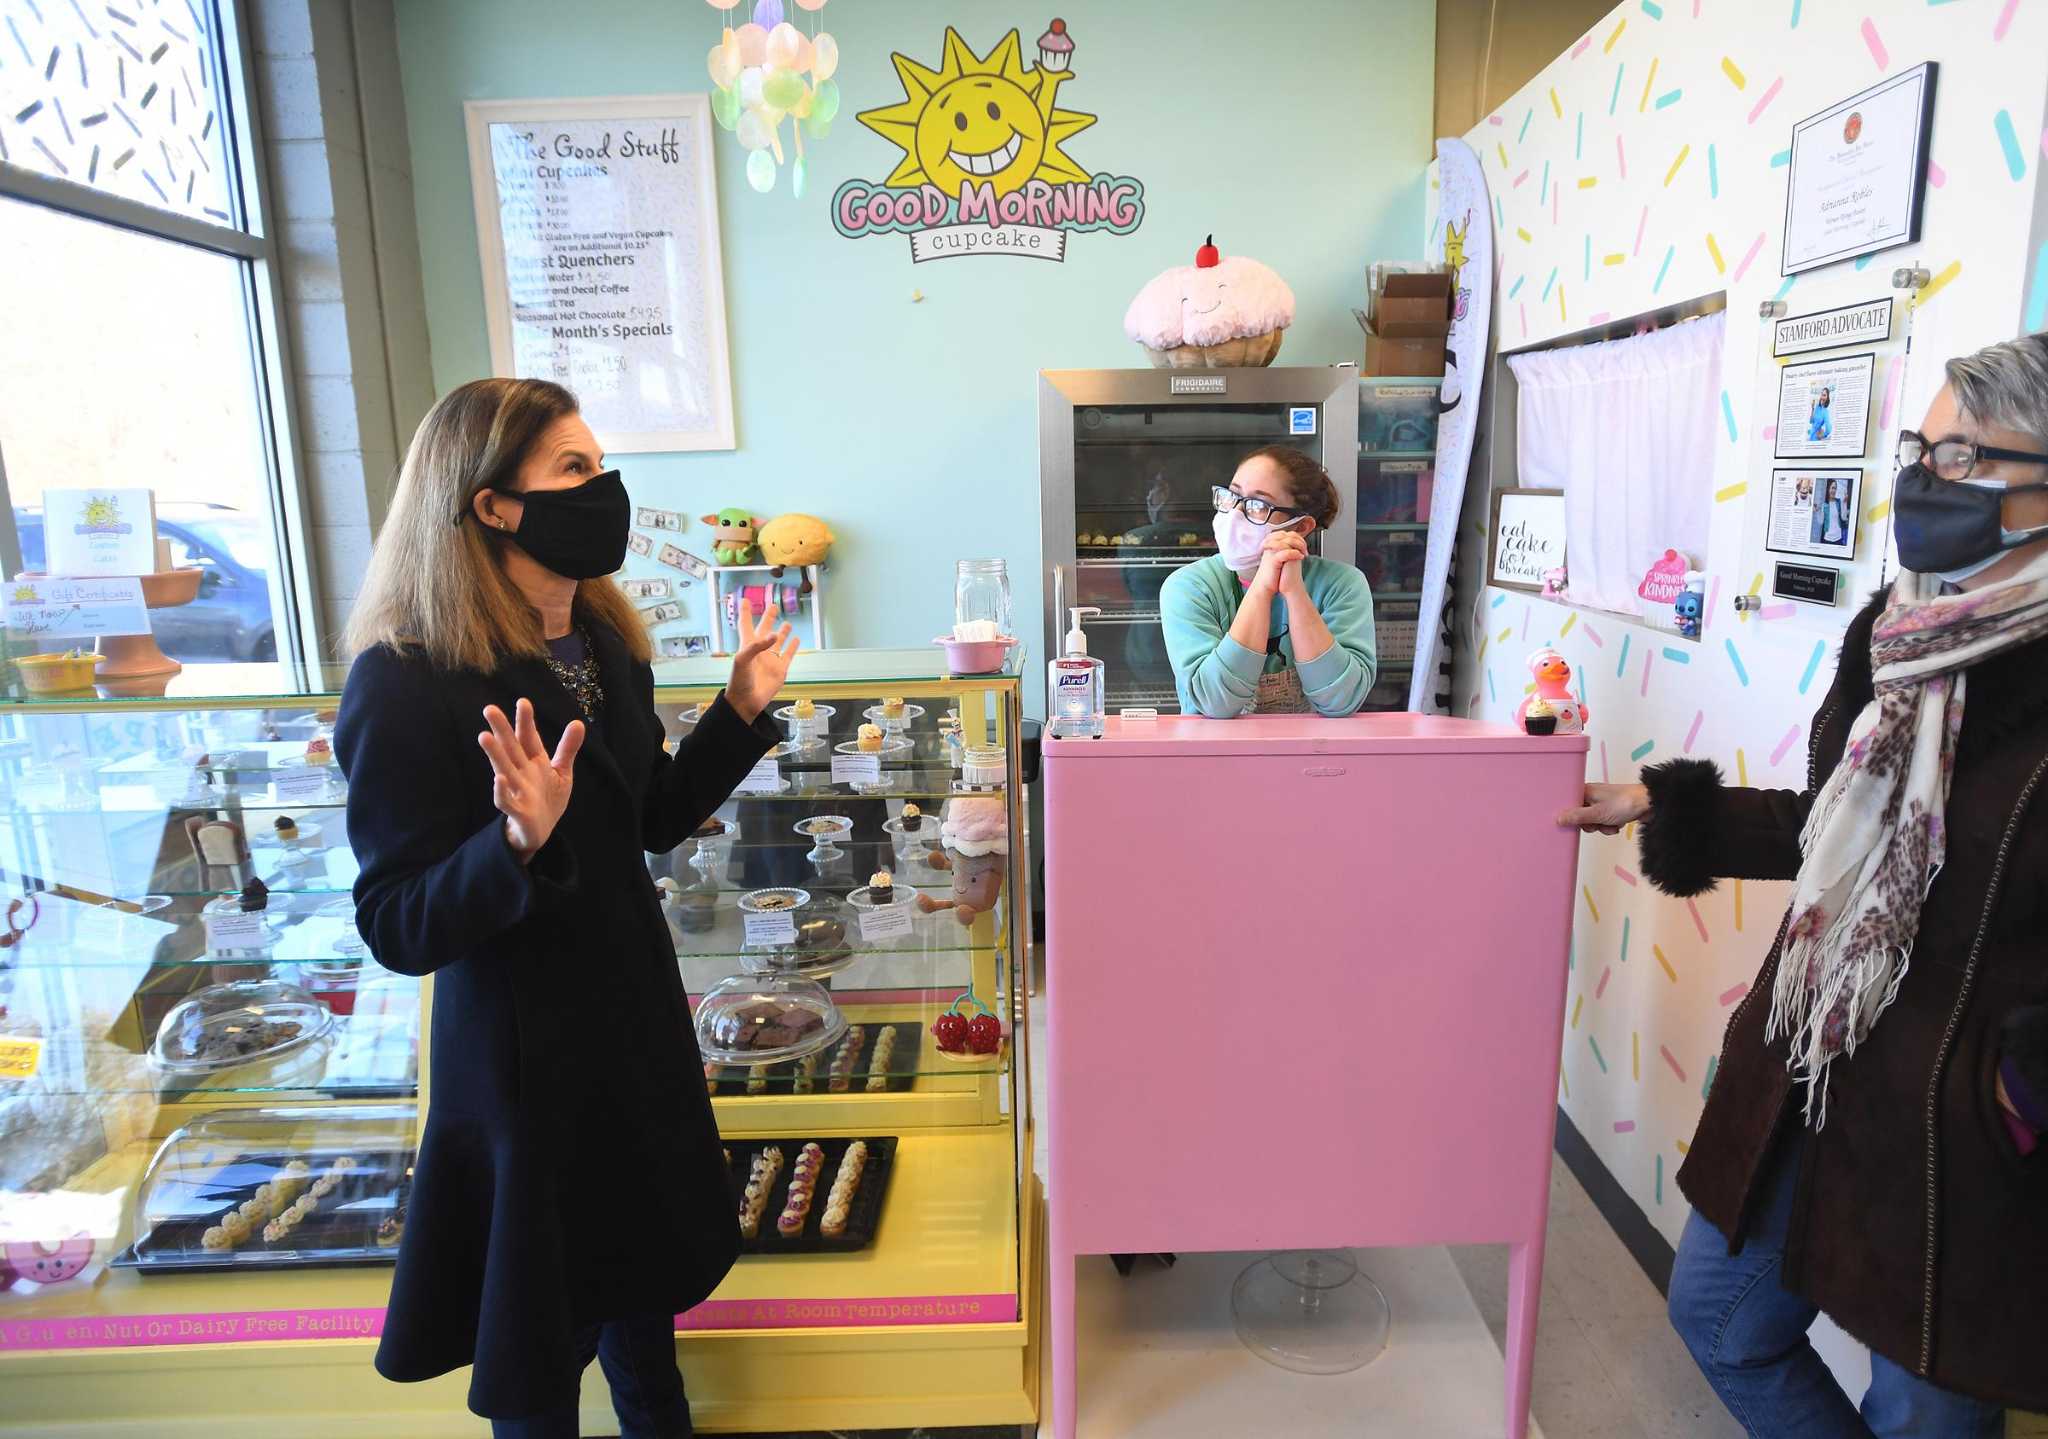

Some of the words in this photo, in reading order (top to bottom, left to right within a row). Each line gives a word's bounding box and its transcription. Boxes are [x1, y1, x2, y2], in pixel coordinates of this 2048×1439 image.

[555, 133, 611, 159] Good
[620, 128, 679, 163] Stuff
[537, 165, 608, 181] Cupcakes
[840, 182, 949, 230] GOOD
[958, 179, 1137, 229] MORNING
[933, 229, 1041, 251] cupcake
[558, 253, 635, 269] Quenchers
[548, 272, 574, 282] Water
[552, 286, 569, 295] and
[572, 284, 598, 295] Decaf
[601, 284, 630, 295] Coffee
[559, 299, 575, 307] Tea
[516, 311, 558, 321] Seasonal
[560, 311, 576, 320] Hot
[578, 309, 626, 319] Chocolate
[552, 324, 609, 338] Month's
[613, 322, 673, 339] Specials
[1779, 319, 1830, 343] STAMFORD
[1831, 308, 1886, 335] ADVOCATE
[1175, 378, 1224, 387] FRIGIDAIRE
[1506, 534, 1552, 553] cake
[1499, 549, 1527, 569] for
[784, 1303, 840, 1319] Room
[844, 1300, 981, 1320] Temperature
[103, 1321, 141, 1341] Nut
[147, 1320, 173, 1337] Or
[179, 1316, 239, 1340] Dairy
[244, 1316, 288, 1333] Free
[294, 1312, 374, 1334] Facility
